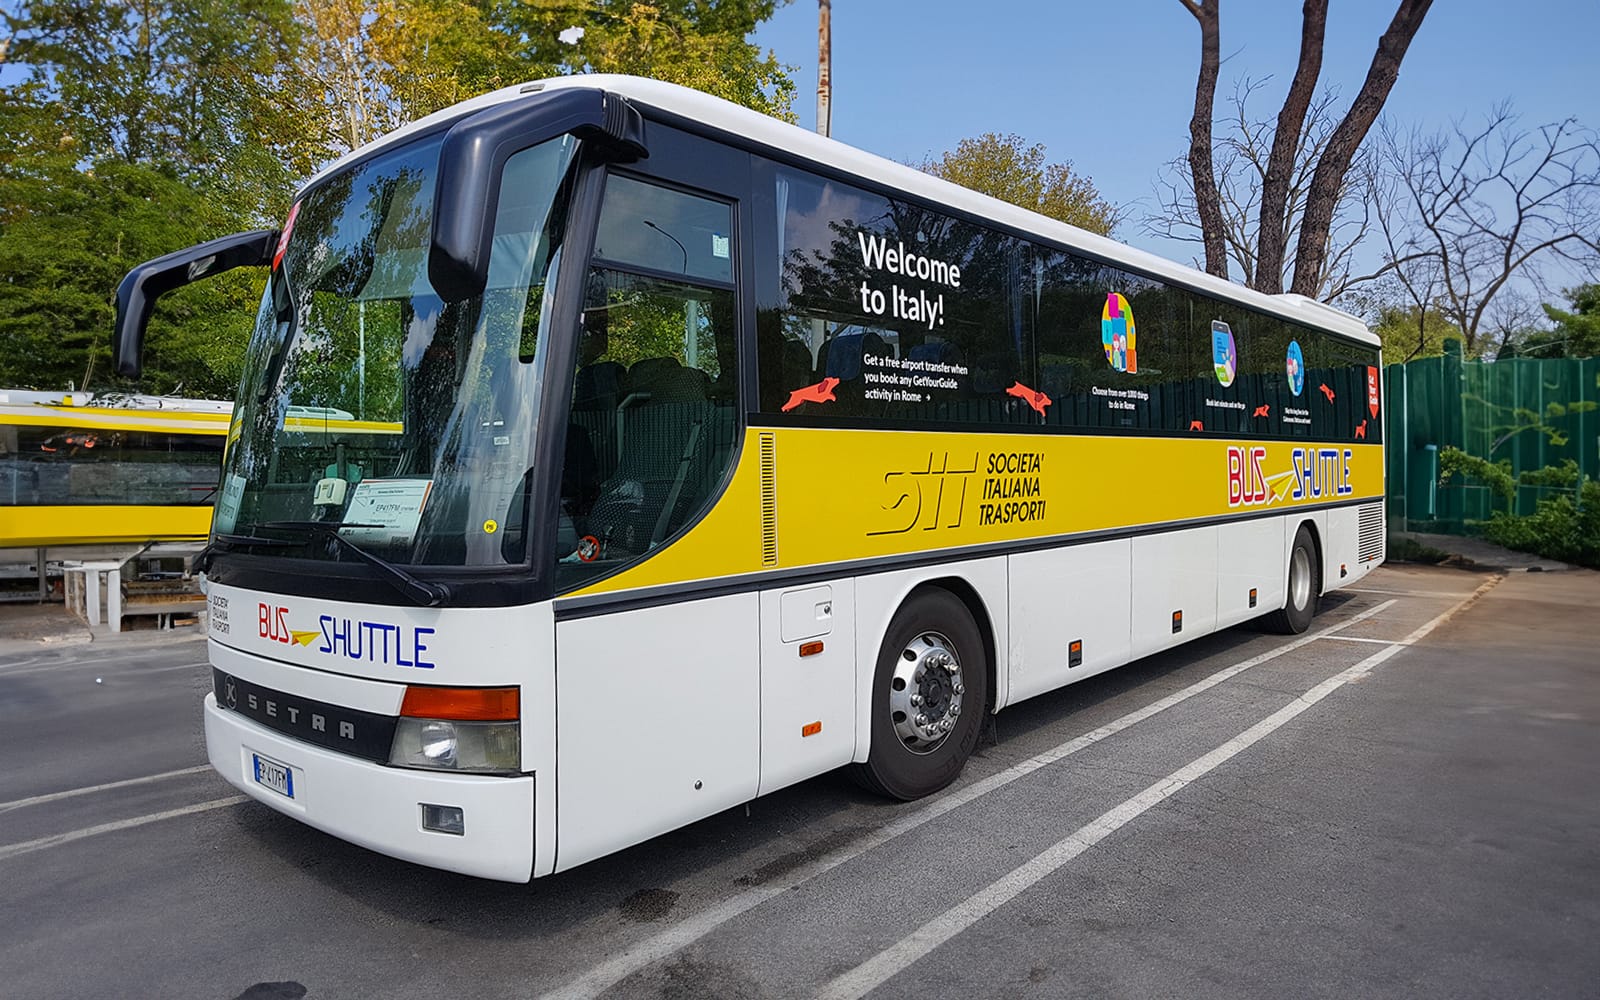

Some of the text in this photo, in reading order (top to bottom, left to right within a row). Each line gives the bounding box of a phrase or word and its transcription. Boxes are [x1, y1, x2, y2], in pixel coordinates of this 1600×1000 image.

[858, 232, 961, 287] Welcome
[860, 281, 944, 330] to Italy!
[863, 353, 968, 375] Get a free airport transfer when
[864, 372, 958, 389] you book any GetYourGuide
[864, 388, 922, 402] activity in Rome
[987, 453, 1045, 474] SOCIETA'
[982, 477, 1041, 500] ITALIANA
[1227, 447, 1353, 507] BUS SHUTTLE
[979, 500, 1046, 526] TRASPORTI
[258, 603, 435, 669] BUS SHUTTLE
[247, 693, 355, 740] SETRA
